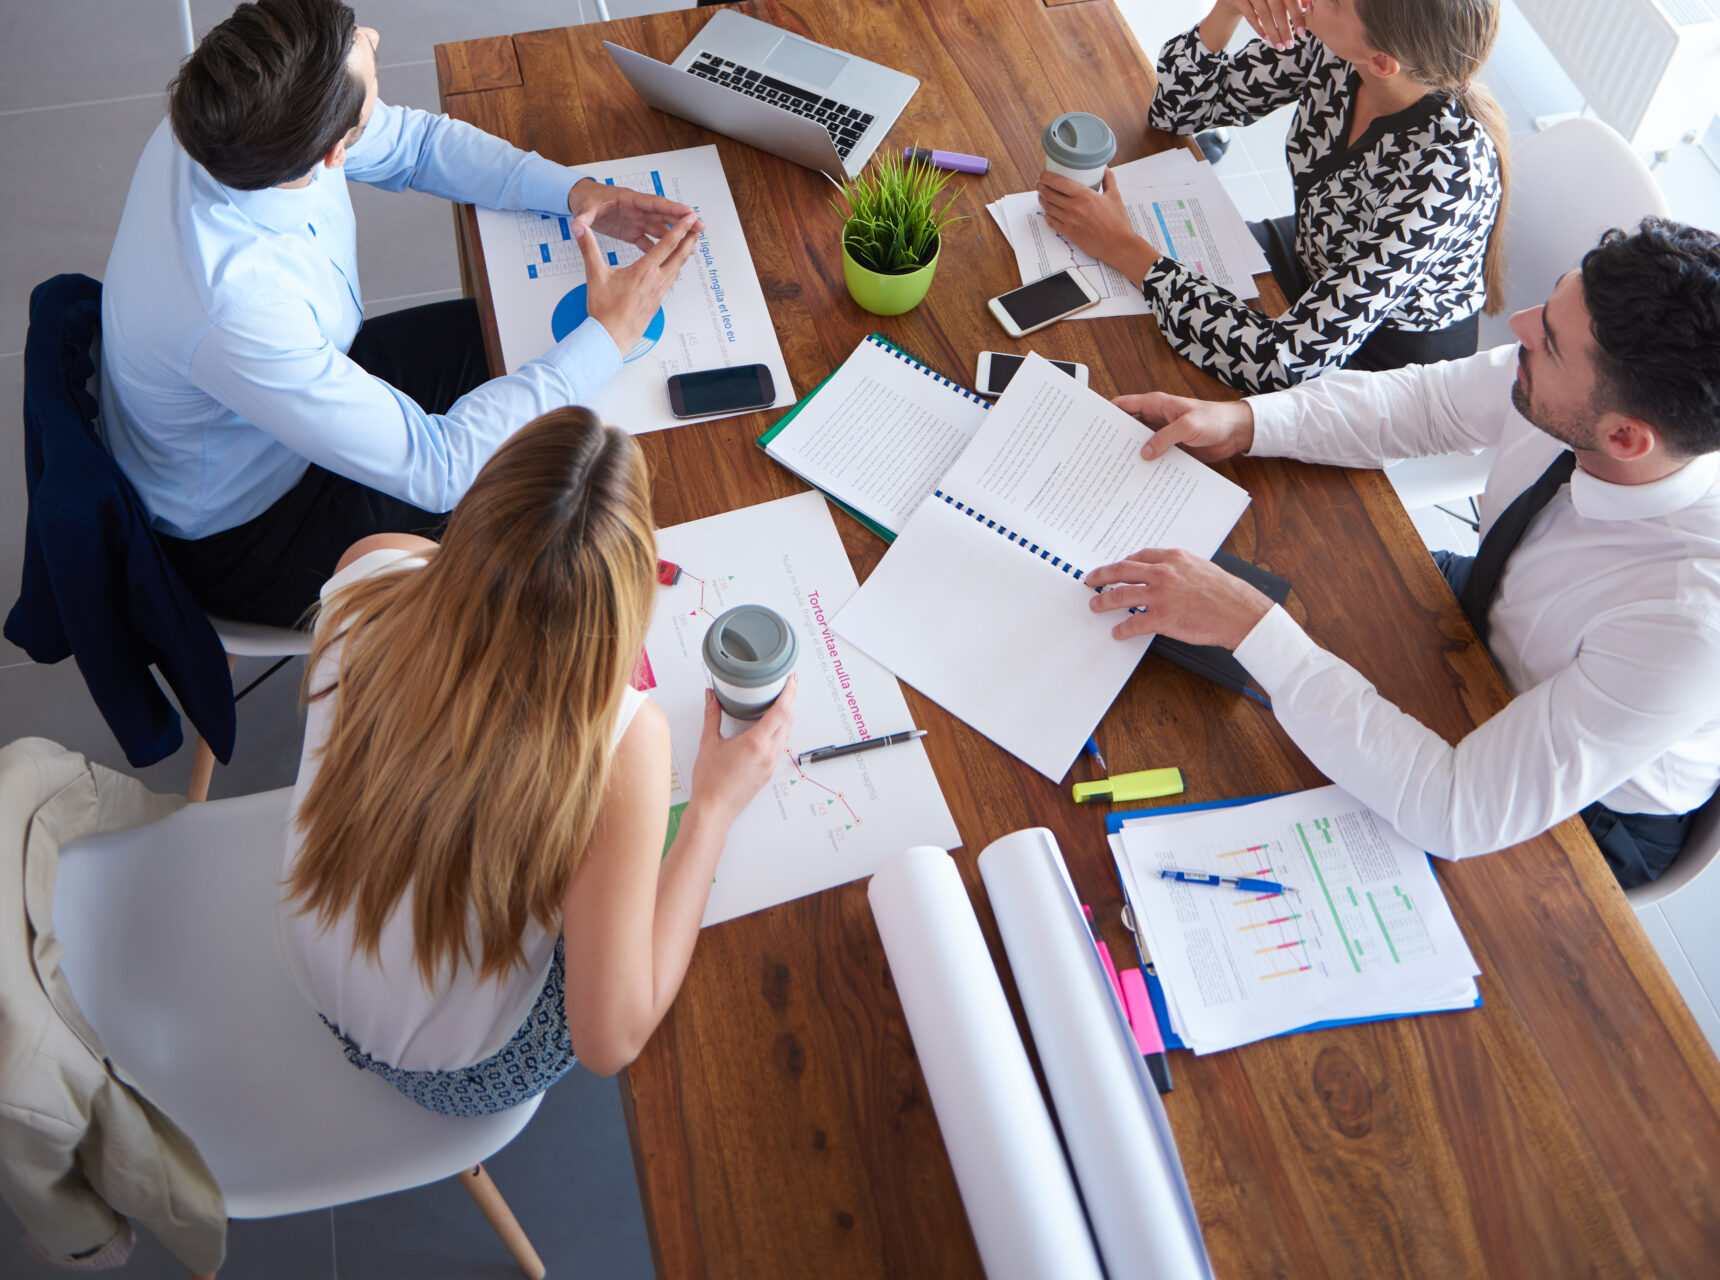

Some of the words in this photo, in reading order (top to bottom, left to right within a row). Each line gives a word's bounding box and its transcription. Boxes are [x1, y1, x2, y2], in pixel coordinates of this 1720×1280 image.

[708, 269, 725, 302] fringilla
[718, 303, 728, 313] et
[721, 314, 732, 329] leo
[726, 330, 736, 342] eu
[808, 589, 828, 626] Tortor
[822, 628, 838, 657] vitae
[833, 659, 851, 689] nulla
[845, 691, 871, 741] venenat
[840, 713, 856, 743] euismo
